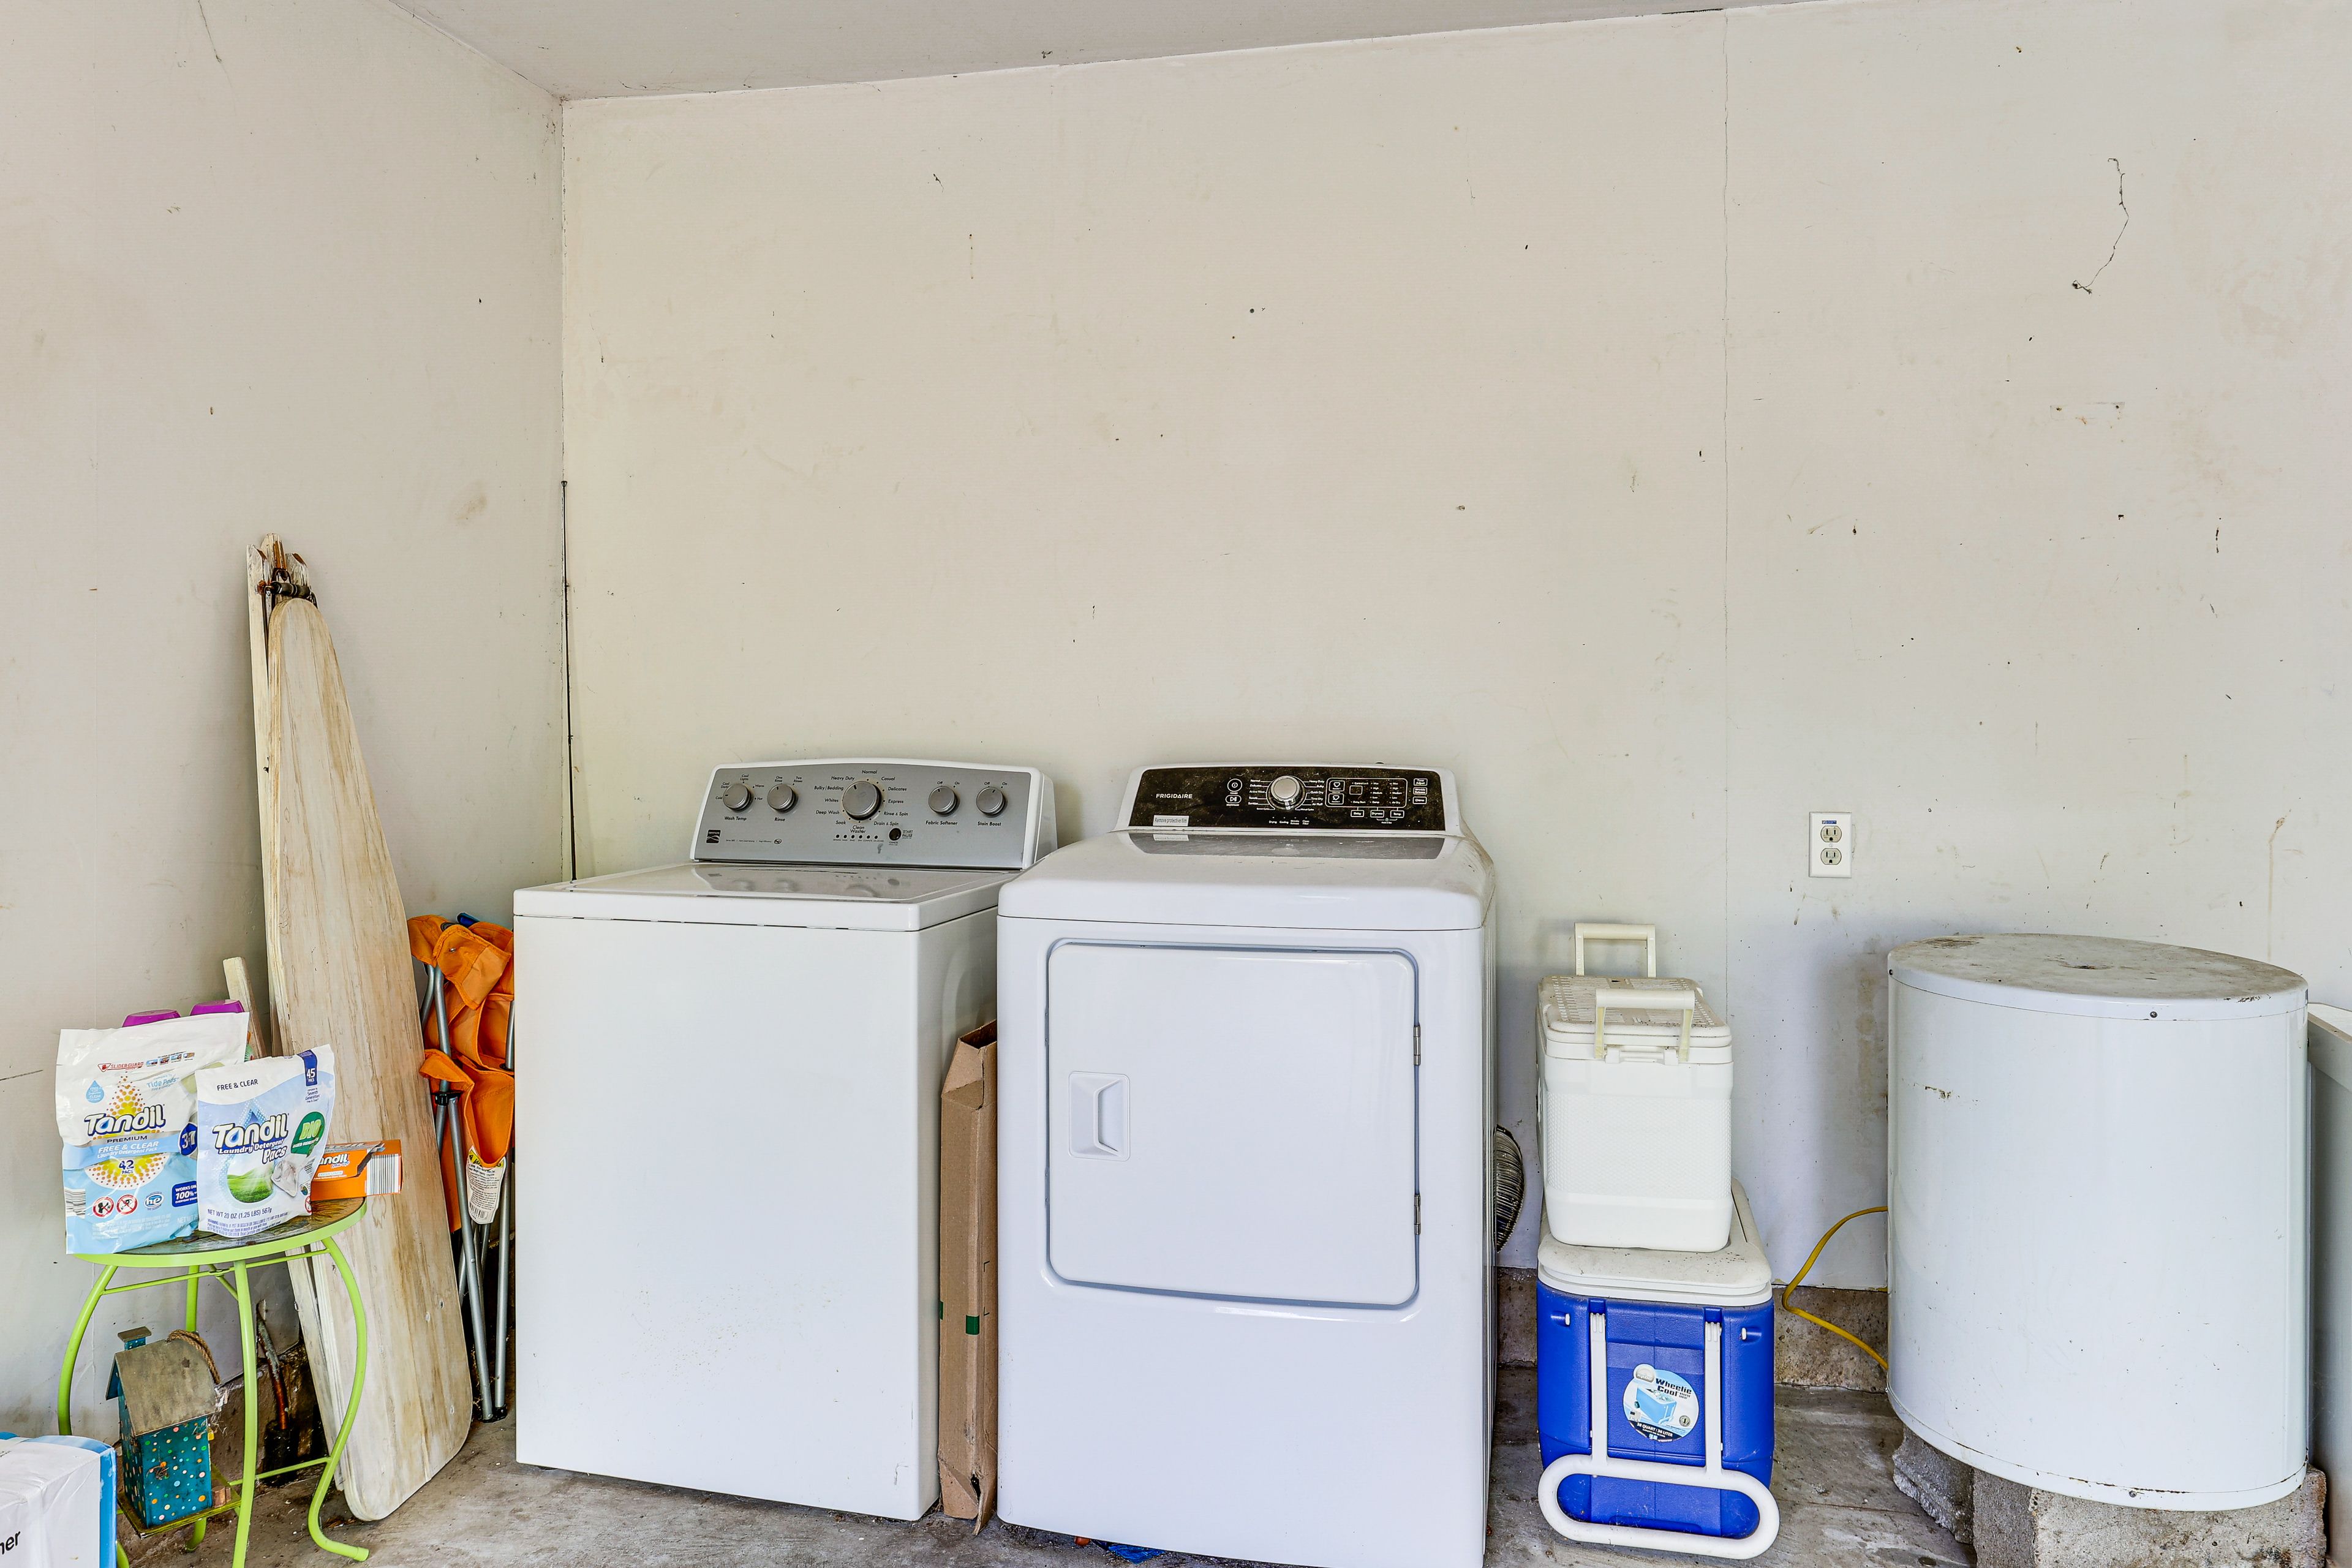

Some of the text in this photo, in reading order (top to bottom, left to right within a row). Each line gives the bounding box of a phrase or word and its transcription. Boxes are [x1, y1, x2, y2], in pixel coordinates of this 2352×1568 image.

[307, 1068, 315, 1079] 45
[239, 1079, 258, 1087] CLEAR
[84, 1104, 166, 1136] Tandil
[213, 1113, 288, 1150] Tandil
[299, 1119, 322, 1140] BIO
[130, 1141, 159, 1150] CLEAR
[218, 1139, 285, 1155] Laundry Detergent
[262, 1145, 288, 1164] Pacs
[119, 1159, 134, 1170] 42
[176, 1191, 194, 1200] 100%
[238, 1211, 250, 1219] (1.25
[1656, 1378, 1692, 1394] Wheelie
[1657, 1385, 1678, 1396] Cool
